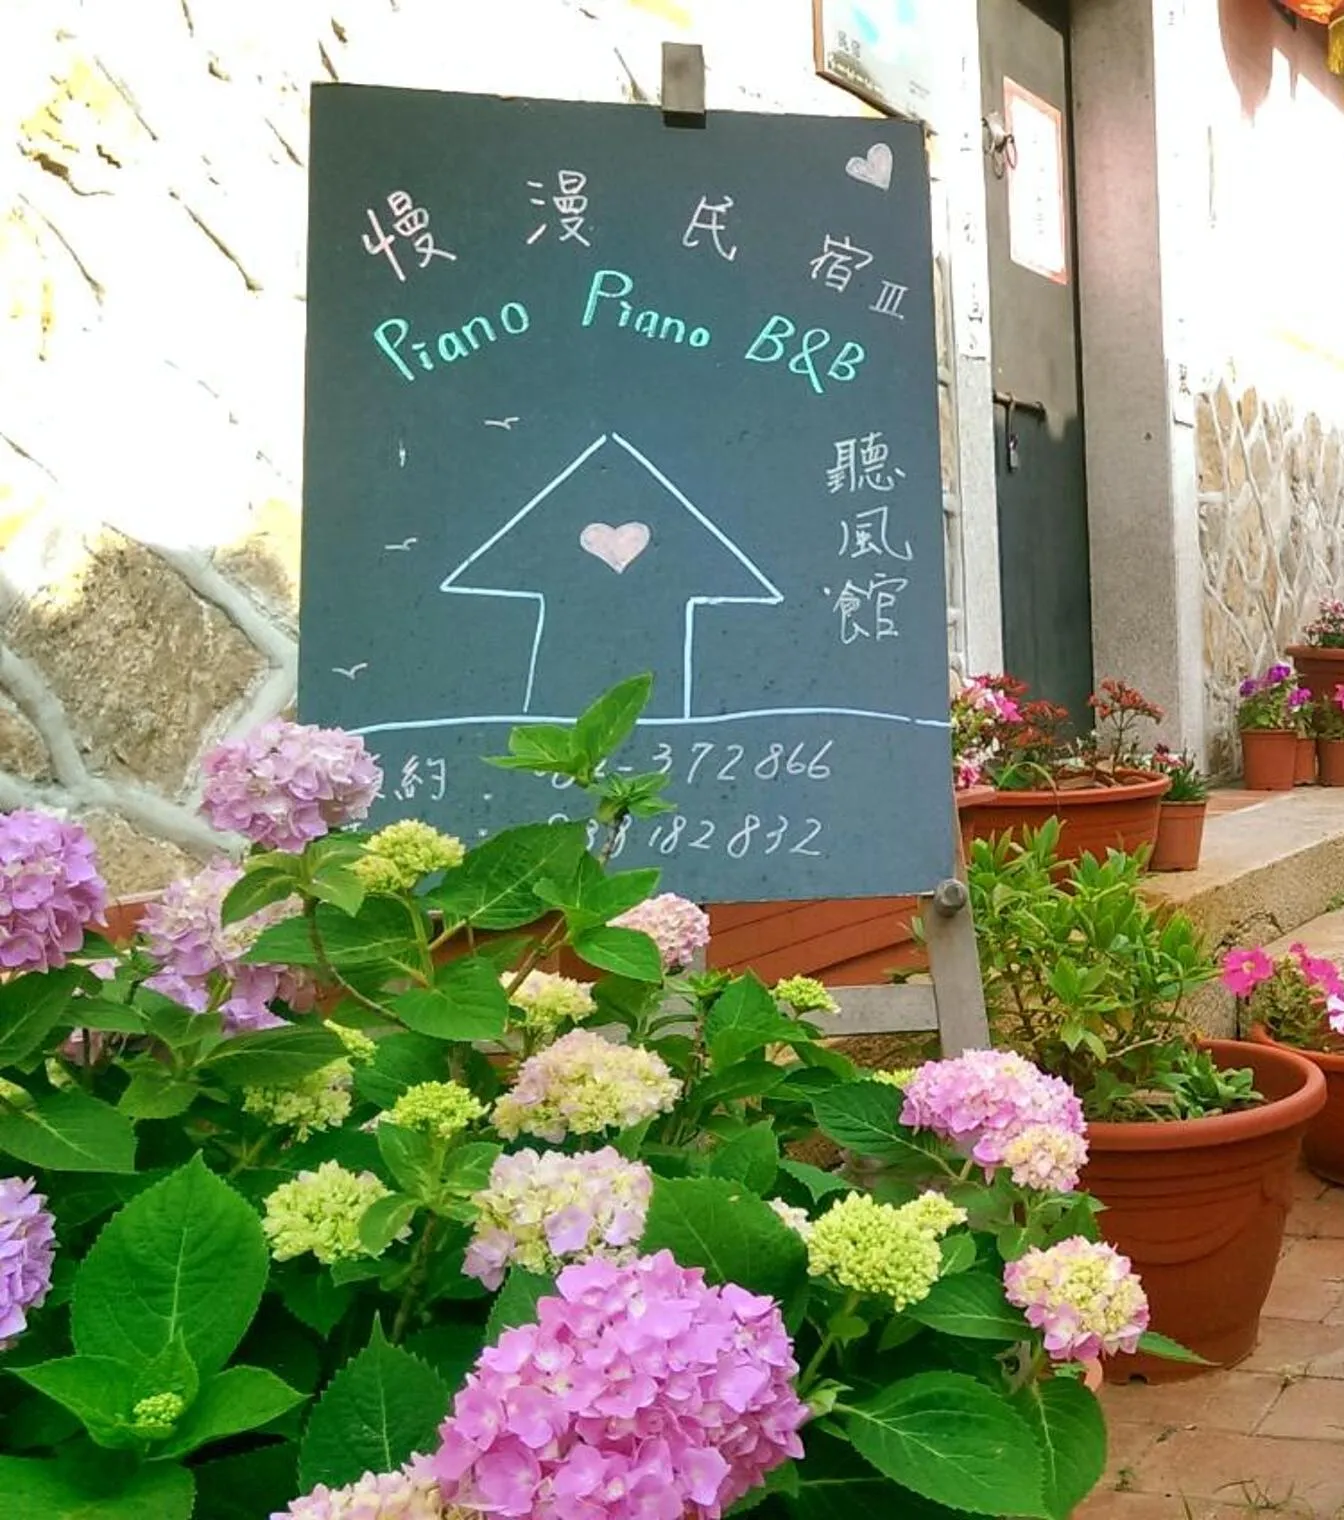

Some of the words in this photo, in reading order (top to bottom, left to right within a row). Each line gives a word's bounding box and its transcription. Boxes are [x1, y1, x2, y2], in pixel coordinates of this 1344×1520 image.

[372, 302, 531, 382] Piano
[580, 269, 712, 348] Piano
[744, 314, 867, 394] B&B
